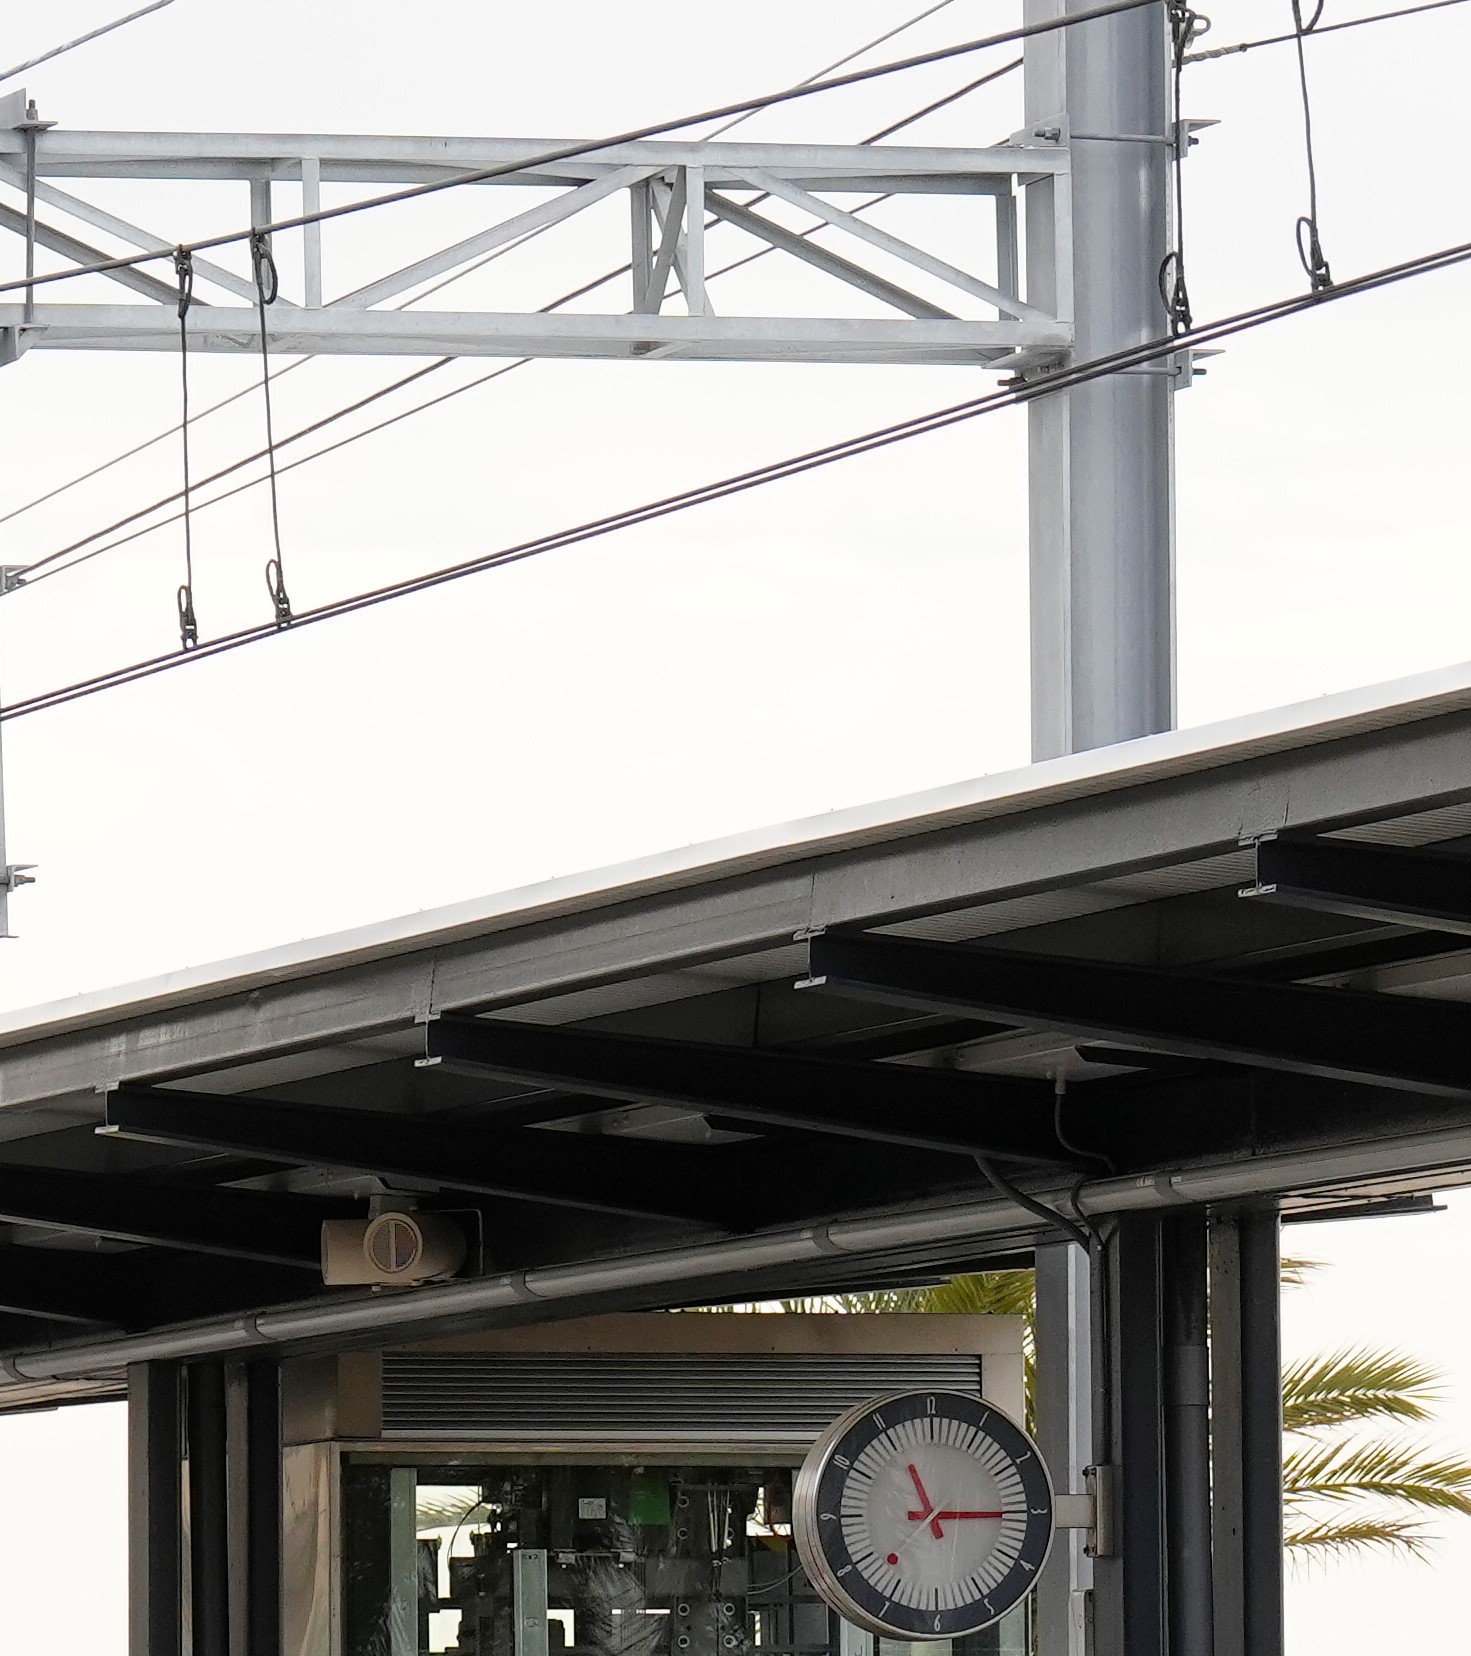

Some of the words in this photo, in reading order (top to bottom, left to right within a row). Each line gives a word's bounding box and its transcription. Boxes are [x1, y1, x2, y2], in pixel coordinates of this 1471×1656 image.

[927, 1396, 935, 1415] 12
[873, 1412, 887, 1430] 11
[979, 1411, 988, 1426] 1
[832, 1454, 850, 1470] 10
[1015, 1450, 1032, 1463] 2
[820, 1512, 837, 1520] 9
[1030, 1506, 1048, 1516] 3
[837, 1564, 852, 1578] 8
[1020, 1560, 1035, 1571] 4
[983, 1598, 995, 1614] 5
[933, 1615, 941, 1631] 6
